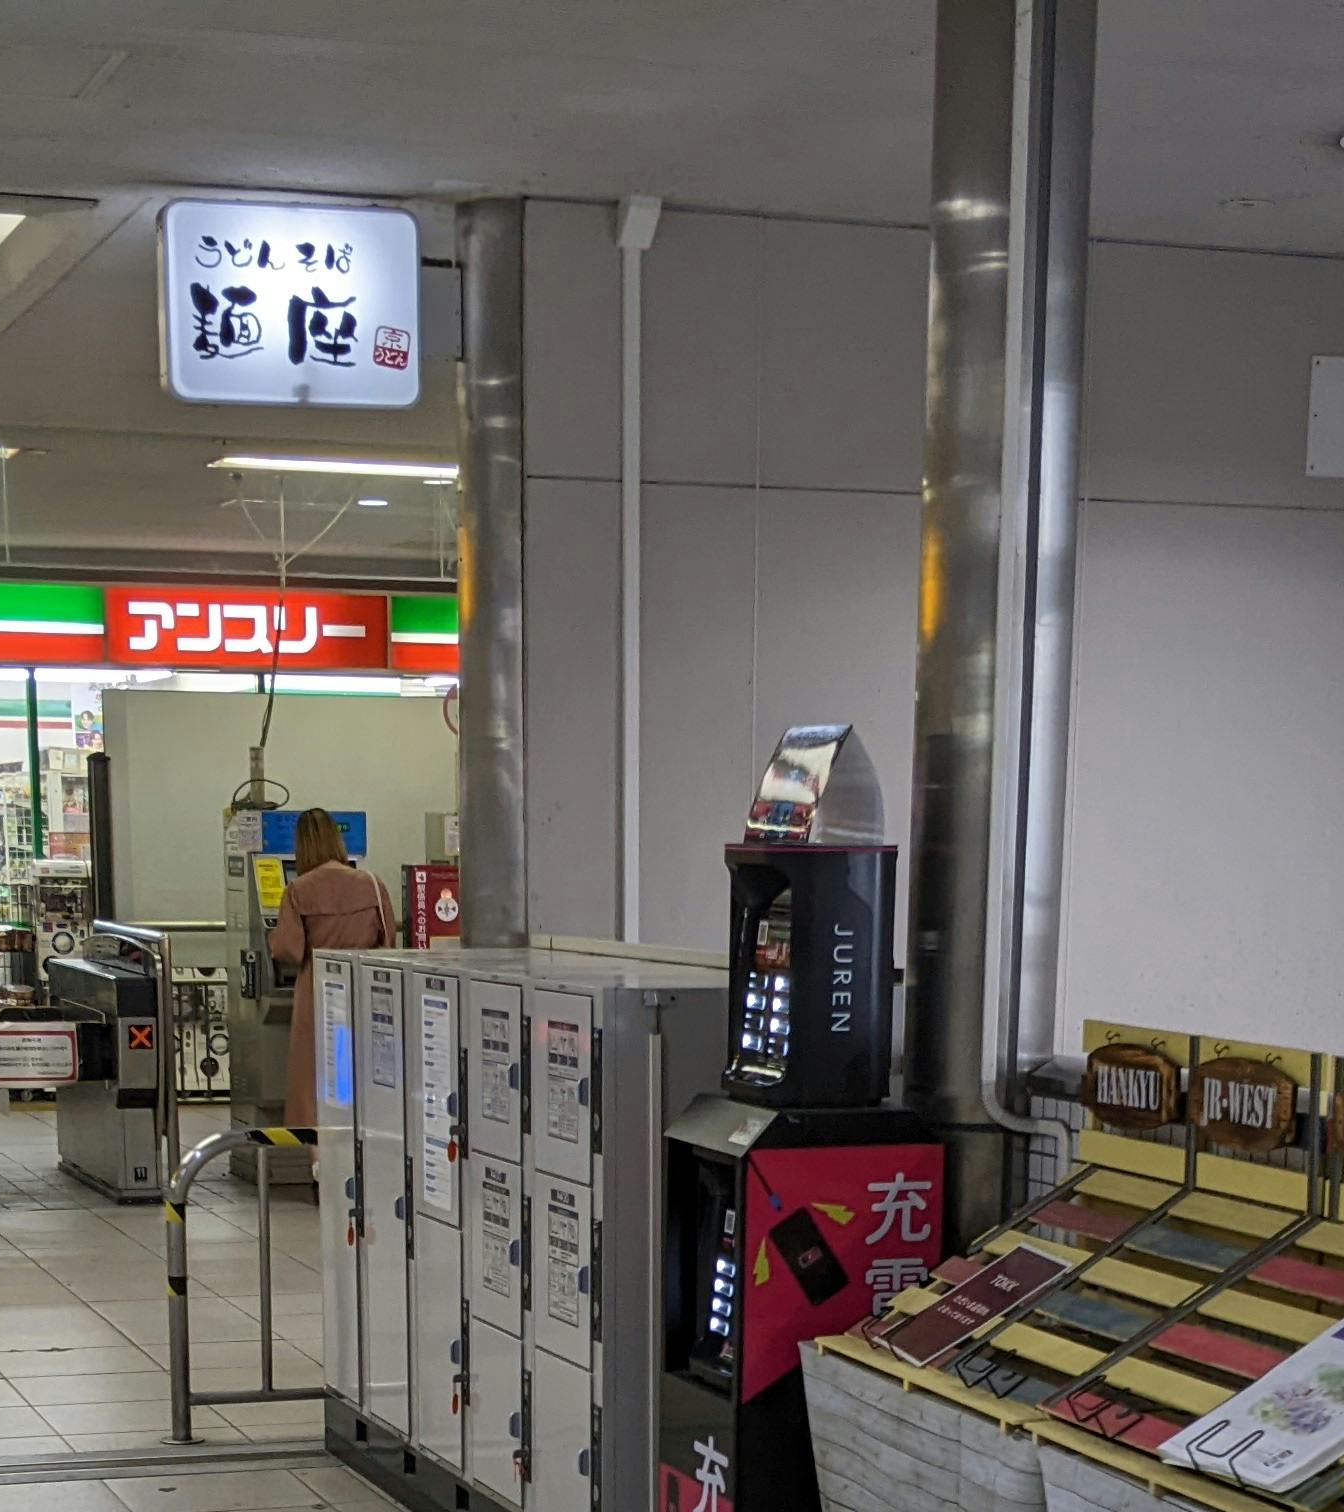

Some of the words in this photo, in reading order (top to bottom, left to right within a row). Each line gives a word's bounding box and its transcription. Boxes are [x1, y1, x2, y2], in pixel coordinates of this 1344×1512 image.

[195, 236, 286, 270] うどん
[296, 242, 352, 274] そば
[127, 600, 367, 655] アンスリー
[831, 923, 854, 1033] JUREN
[1096, 1064, 1161, 1112] HANKYU
